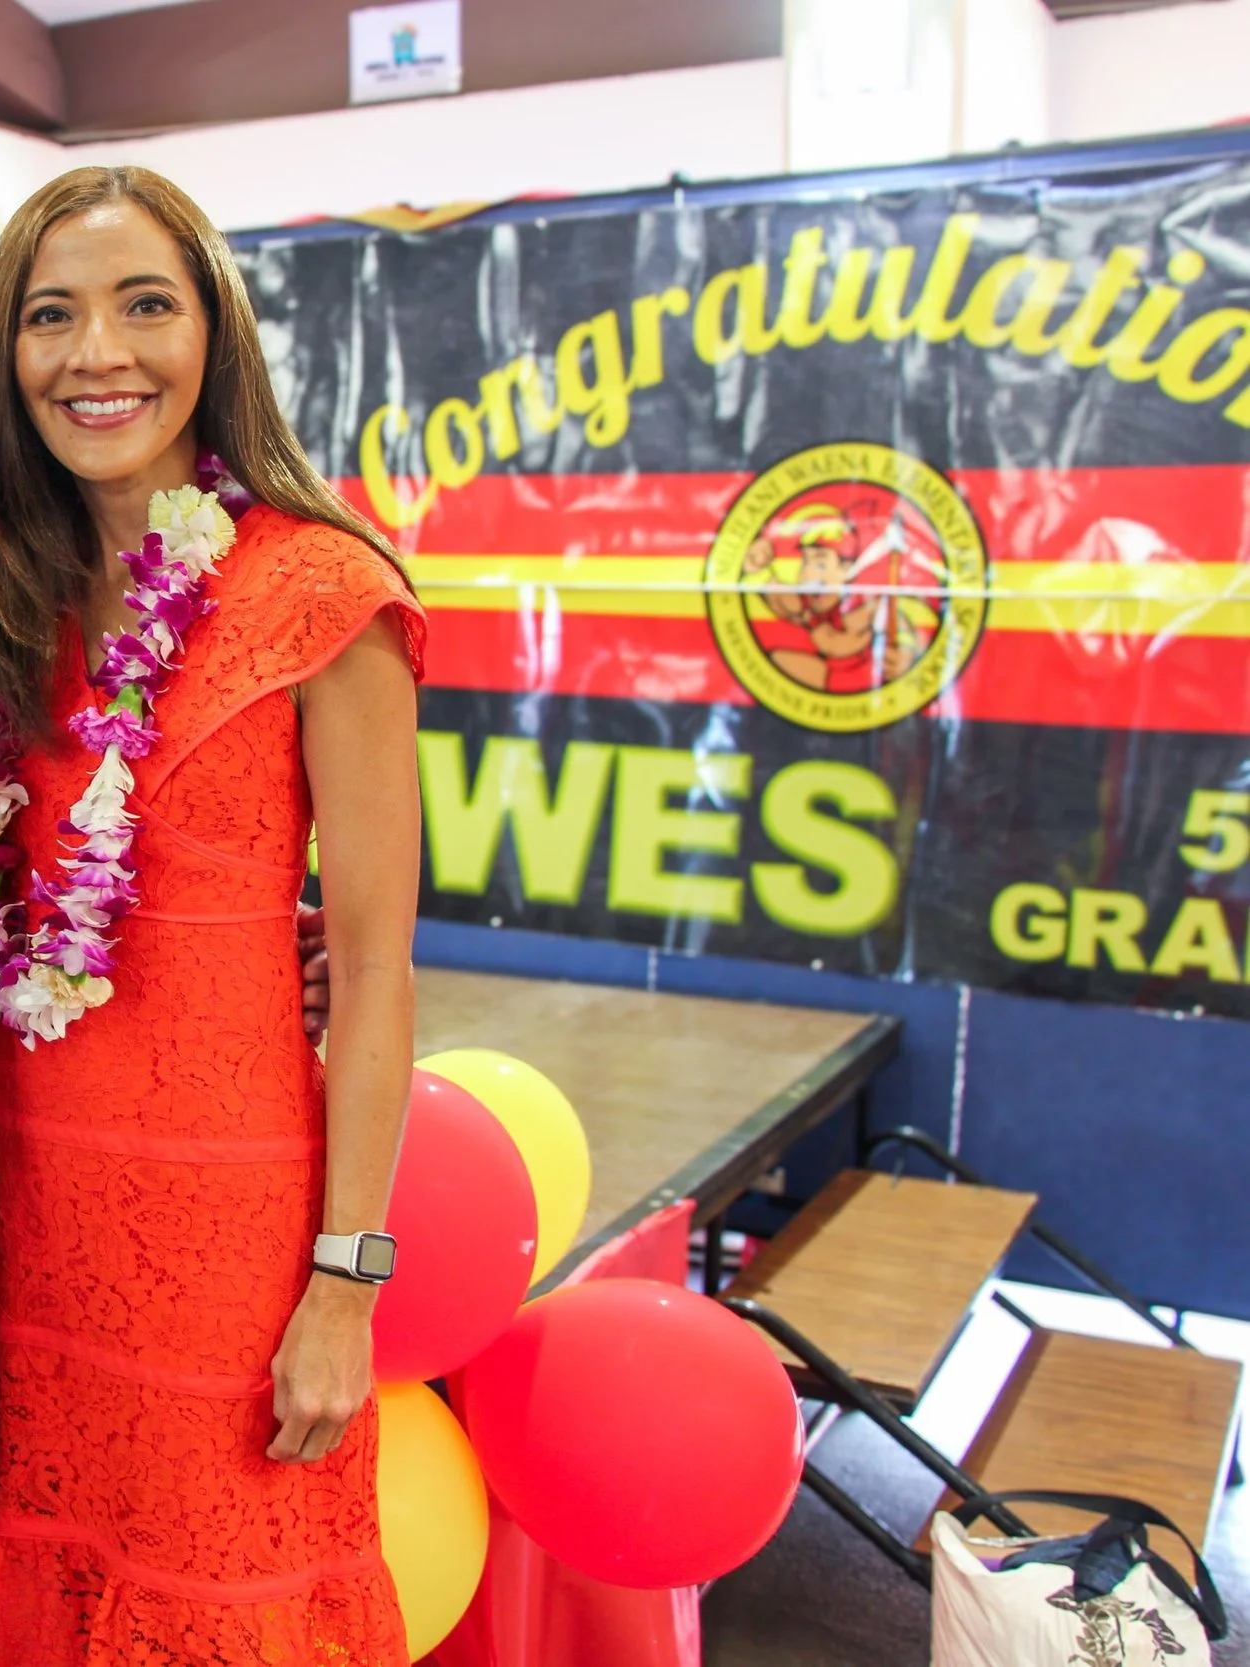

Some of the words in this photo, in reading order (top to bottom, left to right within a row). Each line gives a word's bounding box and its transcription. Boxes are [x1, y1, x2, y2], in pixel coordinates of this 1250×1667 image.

[359, 212, 1250, 530] Congratulatio
[785, 451, 871, 483] WAENA
[906, 604, 975, 694] SOOL
[808, 702, 872, 721] PRIDE
[308, 730, 897, 936] WES
[990, 881, 1250, 986] GRA
